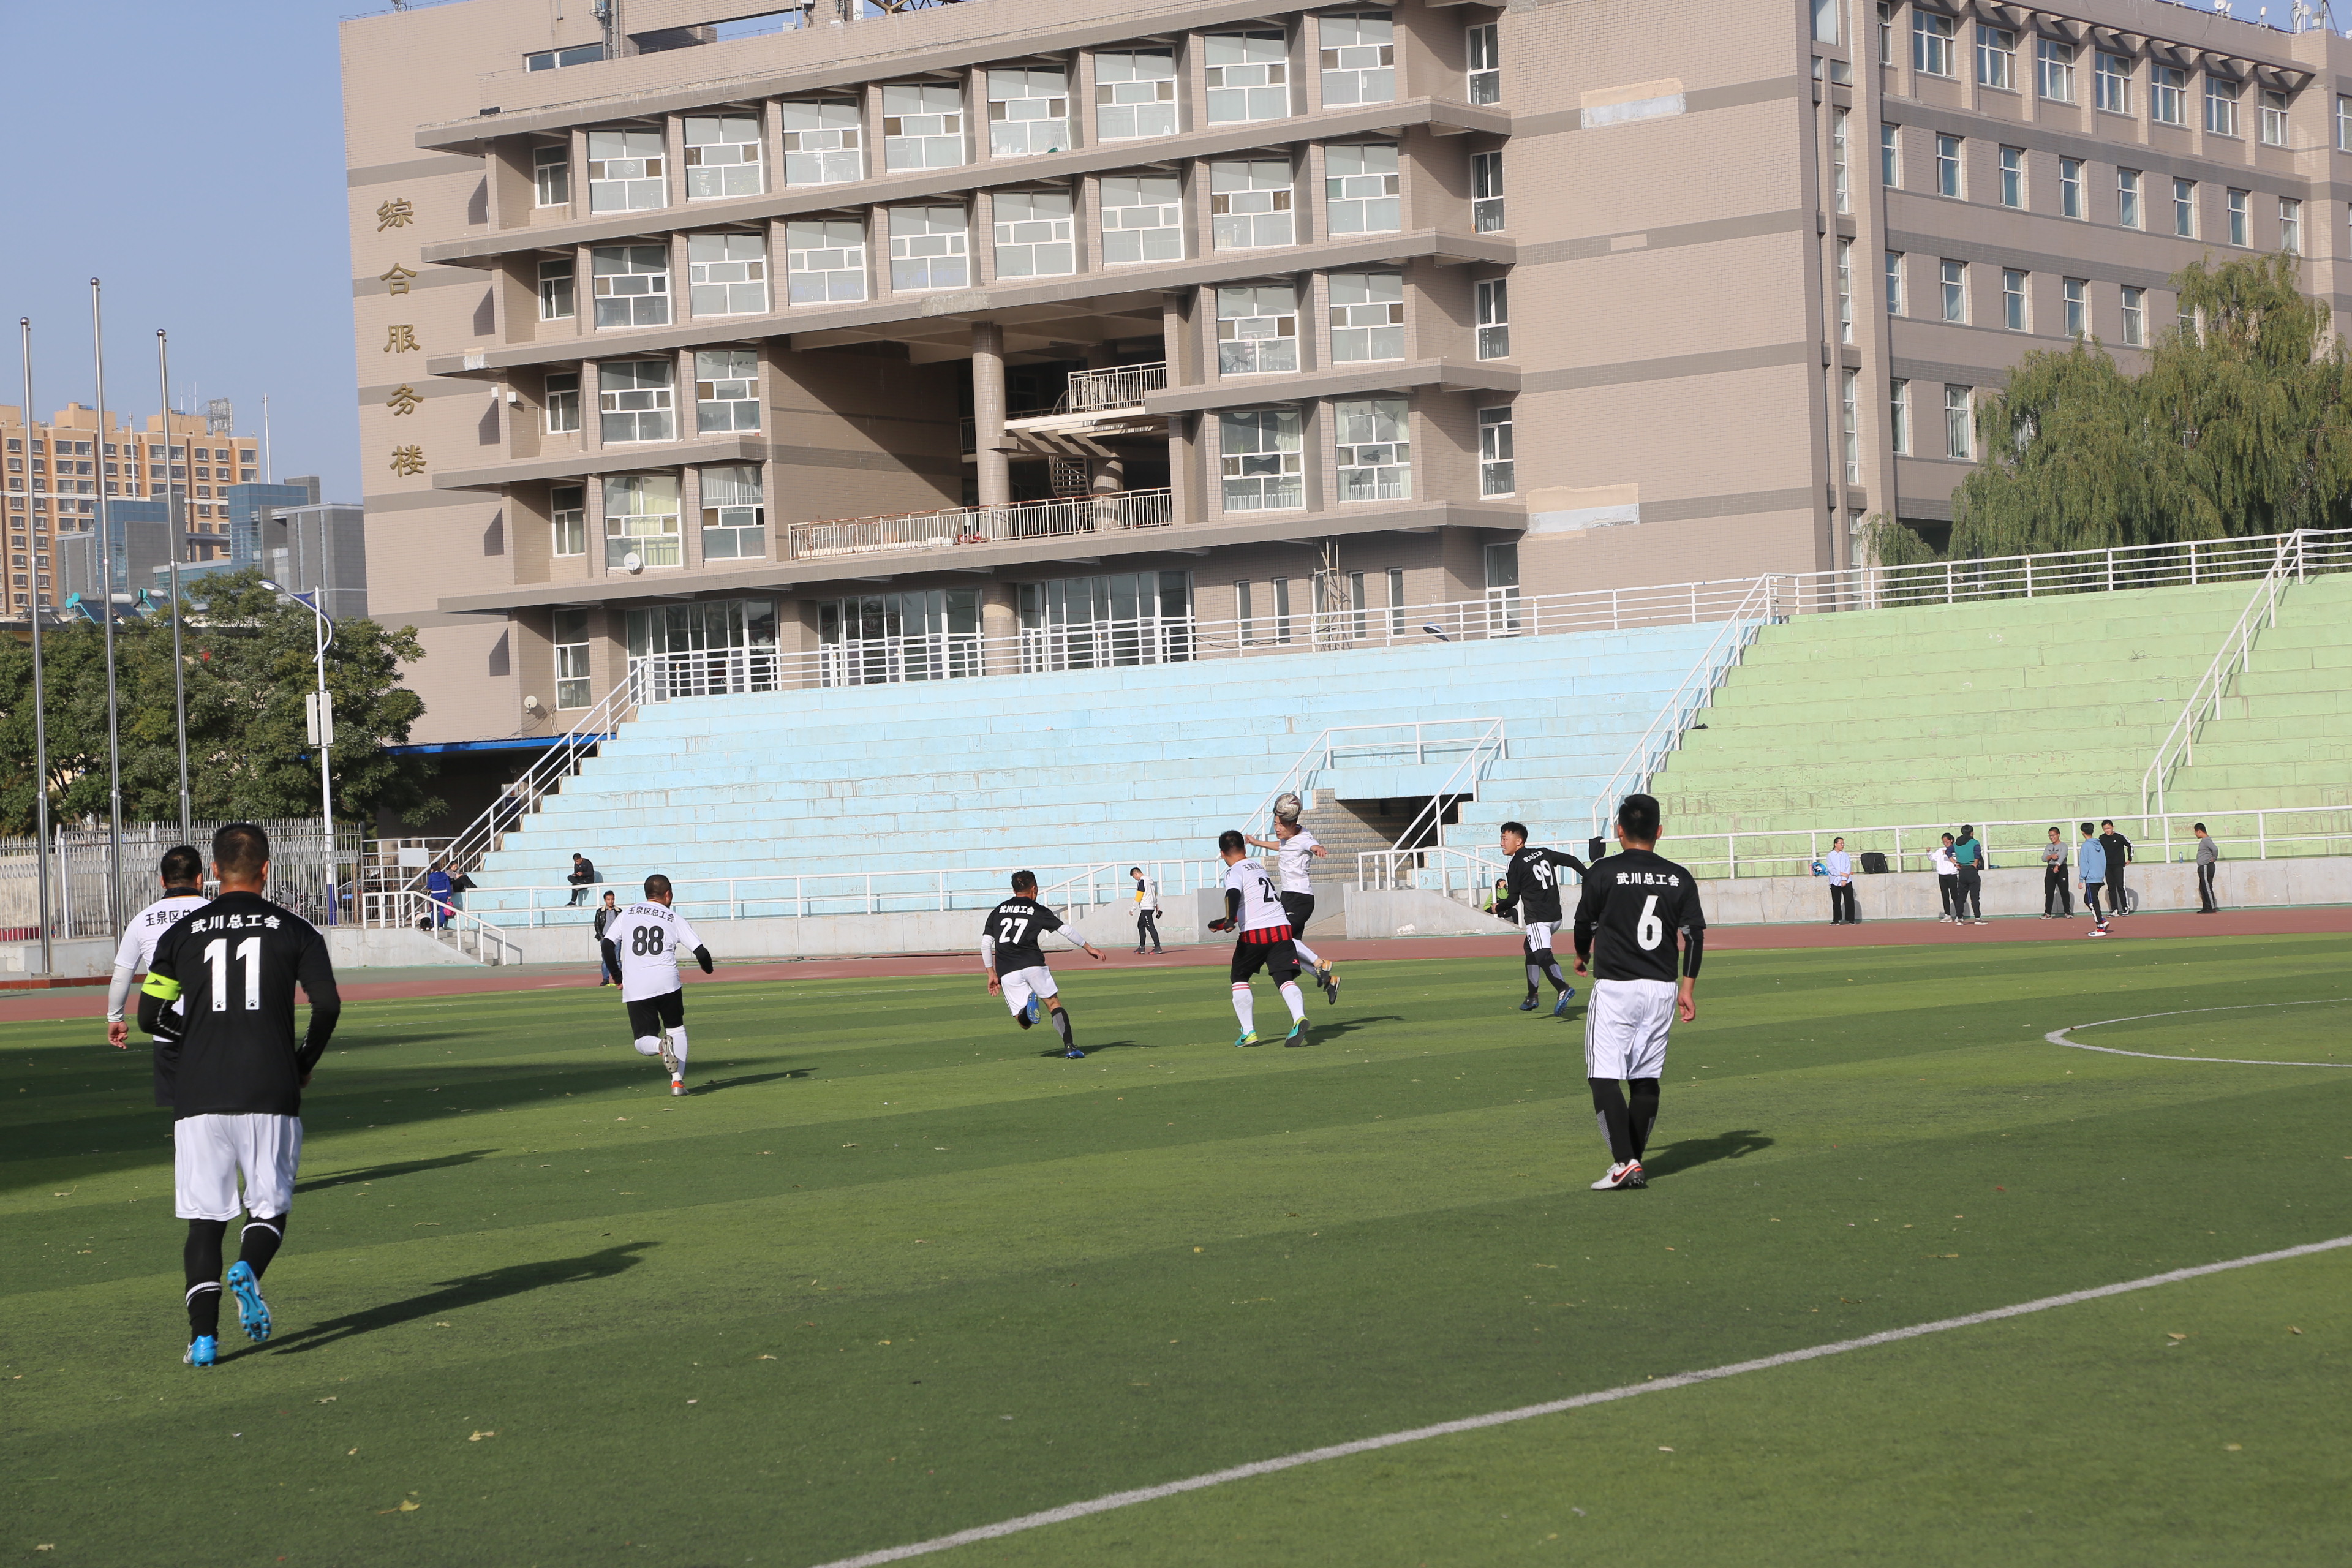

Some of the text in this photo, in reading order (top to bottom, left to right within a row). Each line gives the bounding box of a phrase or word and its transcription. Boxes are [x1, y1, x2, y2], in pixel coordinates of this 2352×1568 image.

[377, 197, 427, 477] 综合服务楼
[1532, 859, 1554, 889] 99
[1616, 872, 1680, 887] 武川总工会
[191, 914, 281, 934] 武川总工会
[628, 907, 675, 922] 玉泉区总工会
[999, 905, 1035, 916] 武川总工会
[1637, 895, 1662, 951] 6
[632, 925, 664, 956] 88
[999, 917, 1028, 944] 27
[203, 937, 262, 1012] 11
